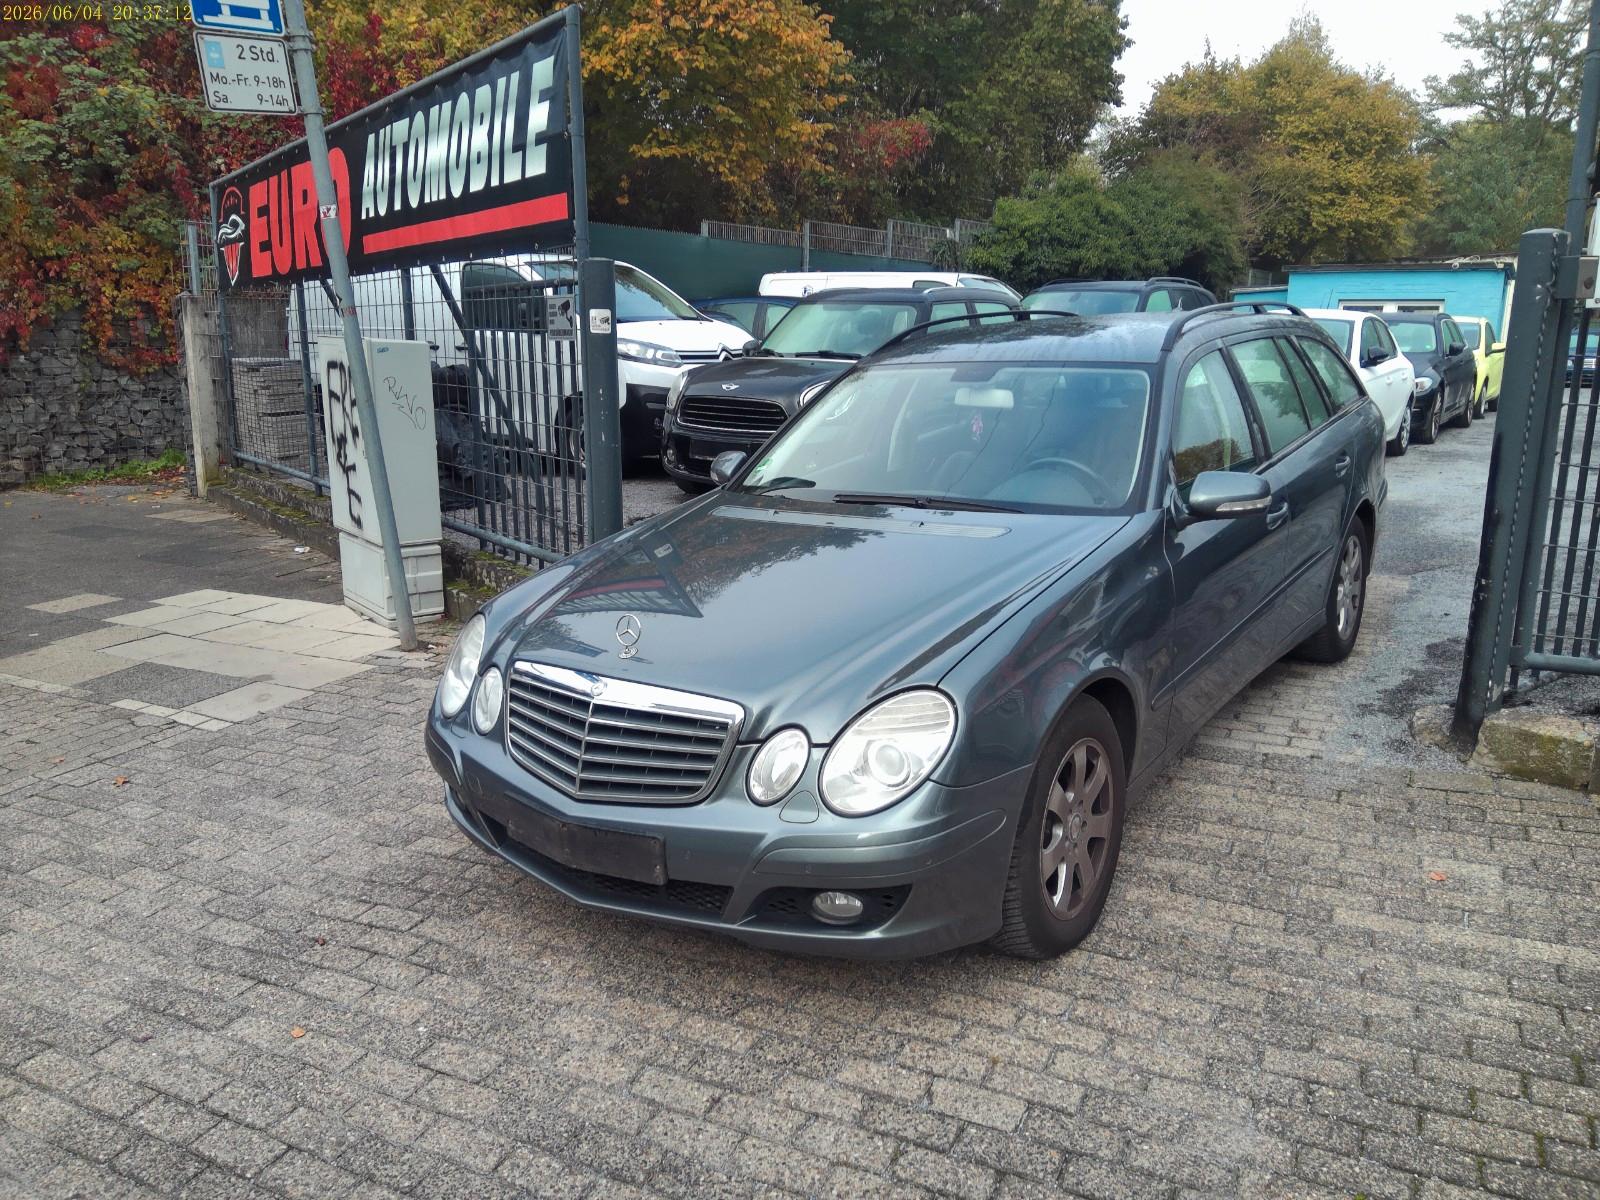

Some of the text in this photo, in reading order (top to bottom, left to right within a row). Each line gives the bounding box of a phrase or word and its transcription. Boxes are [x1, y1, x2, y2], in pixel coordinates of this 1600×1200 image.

[235, 43, 279, 63] 2 Std.
[209, 71, 286, 89] Mo.-Fr. 9-18h
[213, 90, 289, 107] Sa. 9-14h
[361, 55, 554, 220] AUTOMOBILE
